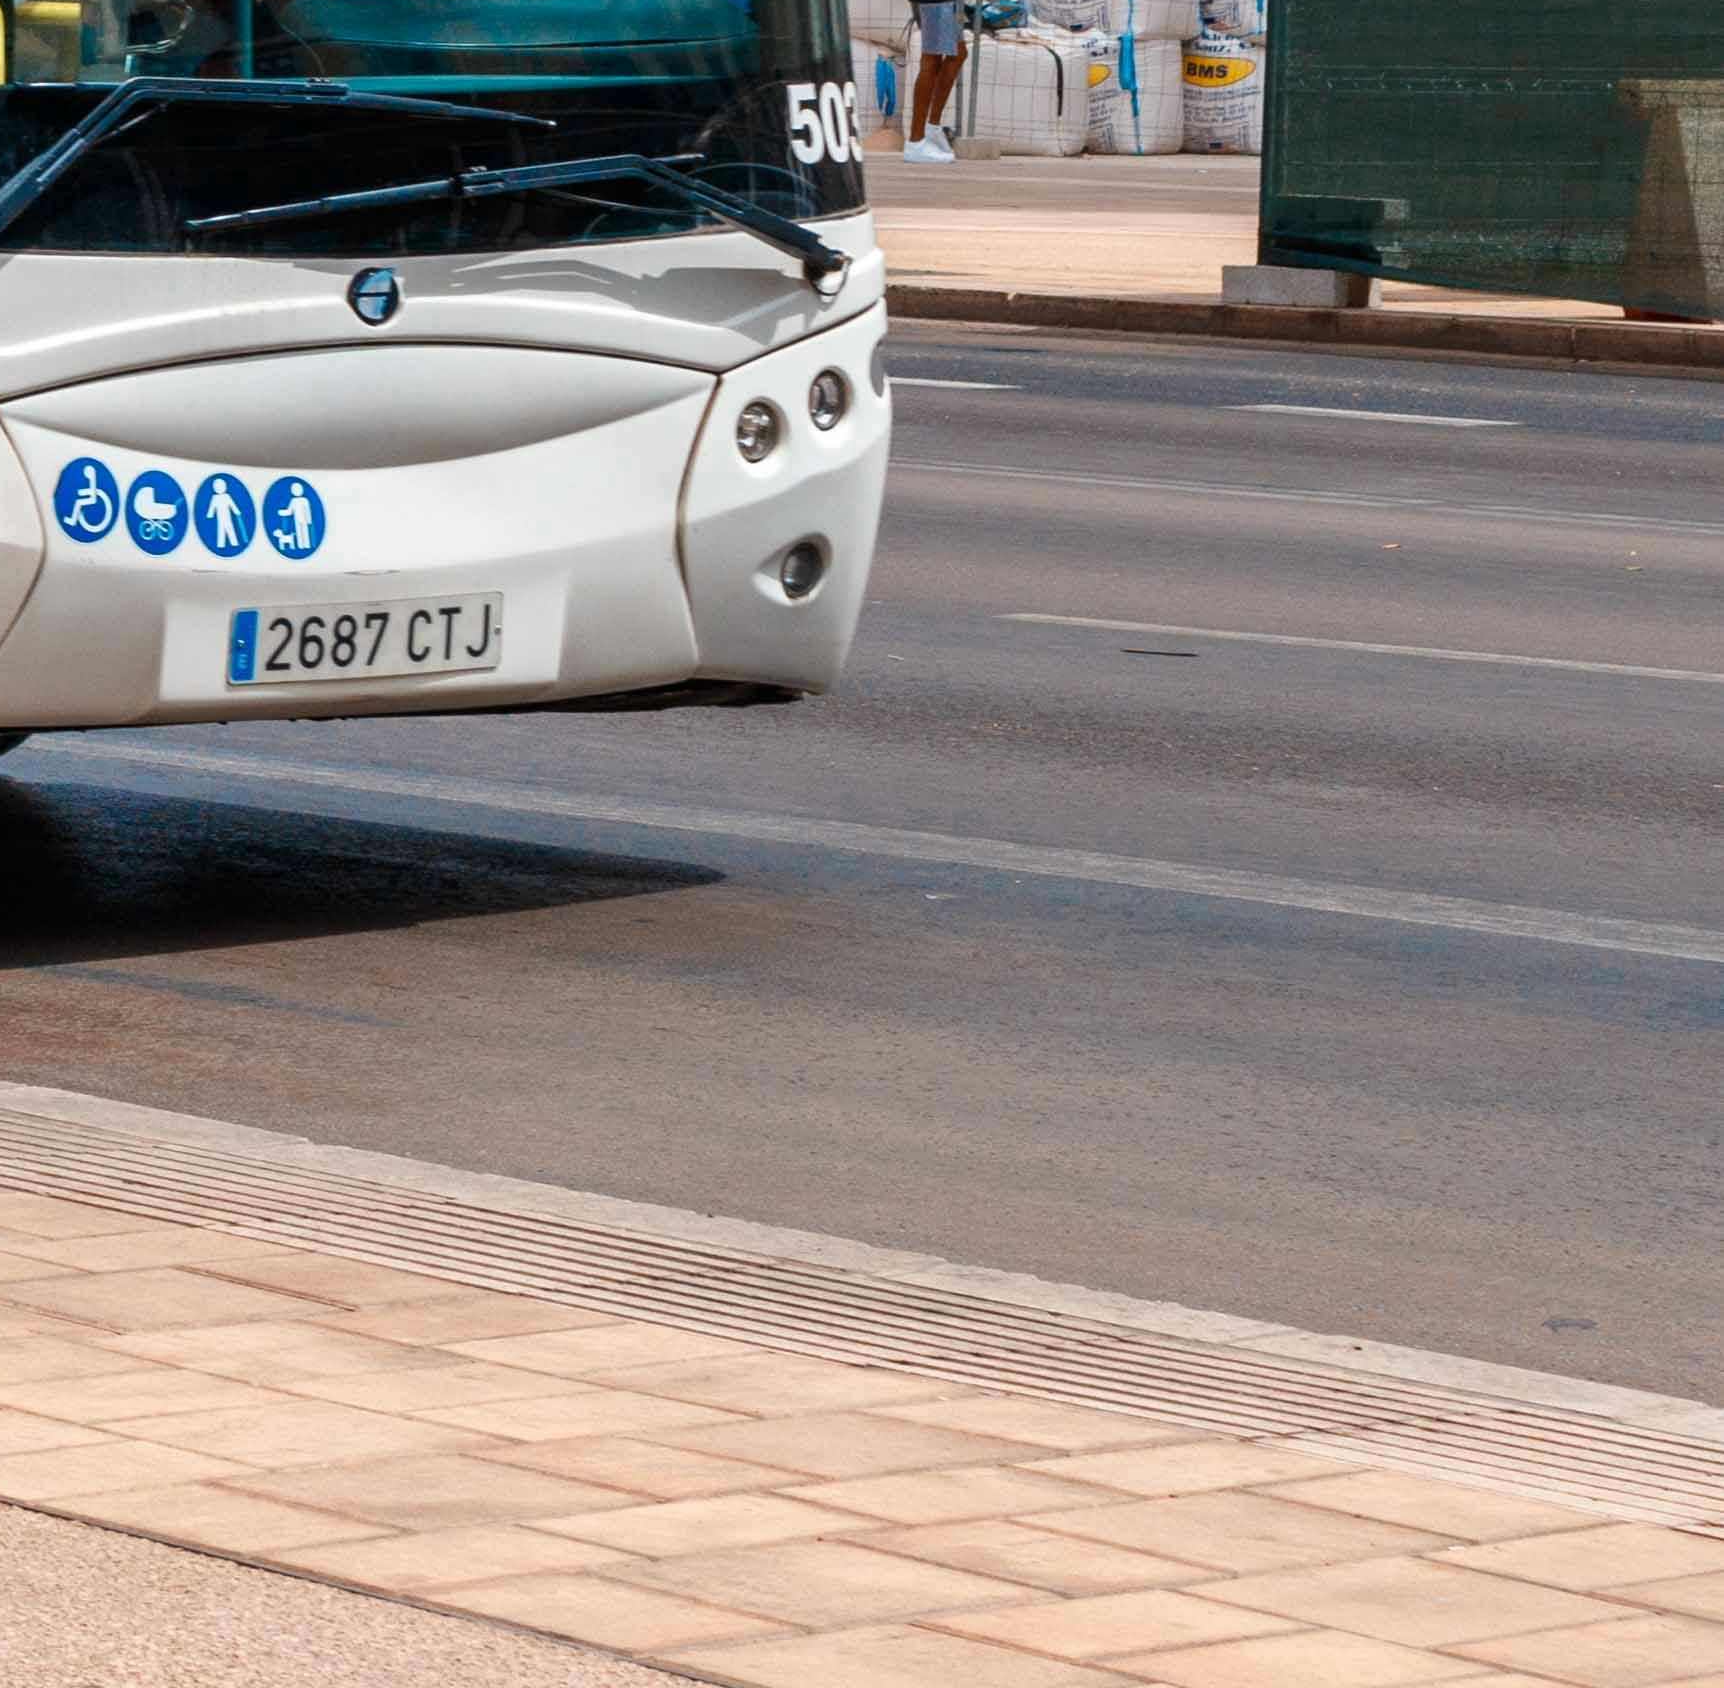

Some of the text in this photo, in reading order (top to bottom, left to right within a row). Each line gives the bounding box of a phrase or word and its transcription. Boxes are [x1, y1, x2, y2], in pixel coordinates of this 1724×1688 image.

[1185, 63, 1229, 79] BMS
[263, 603, 492, 672] 2687 CTJ
